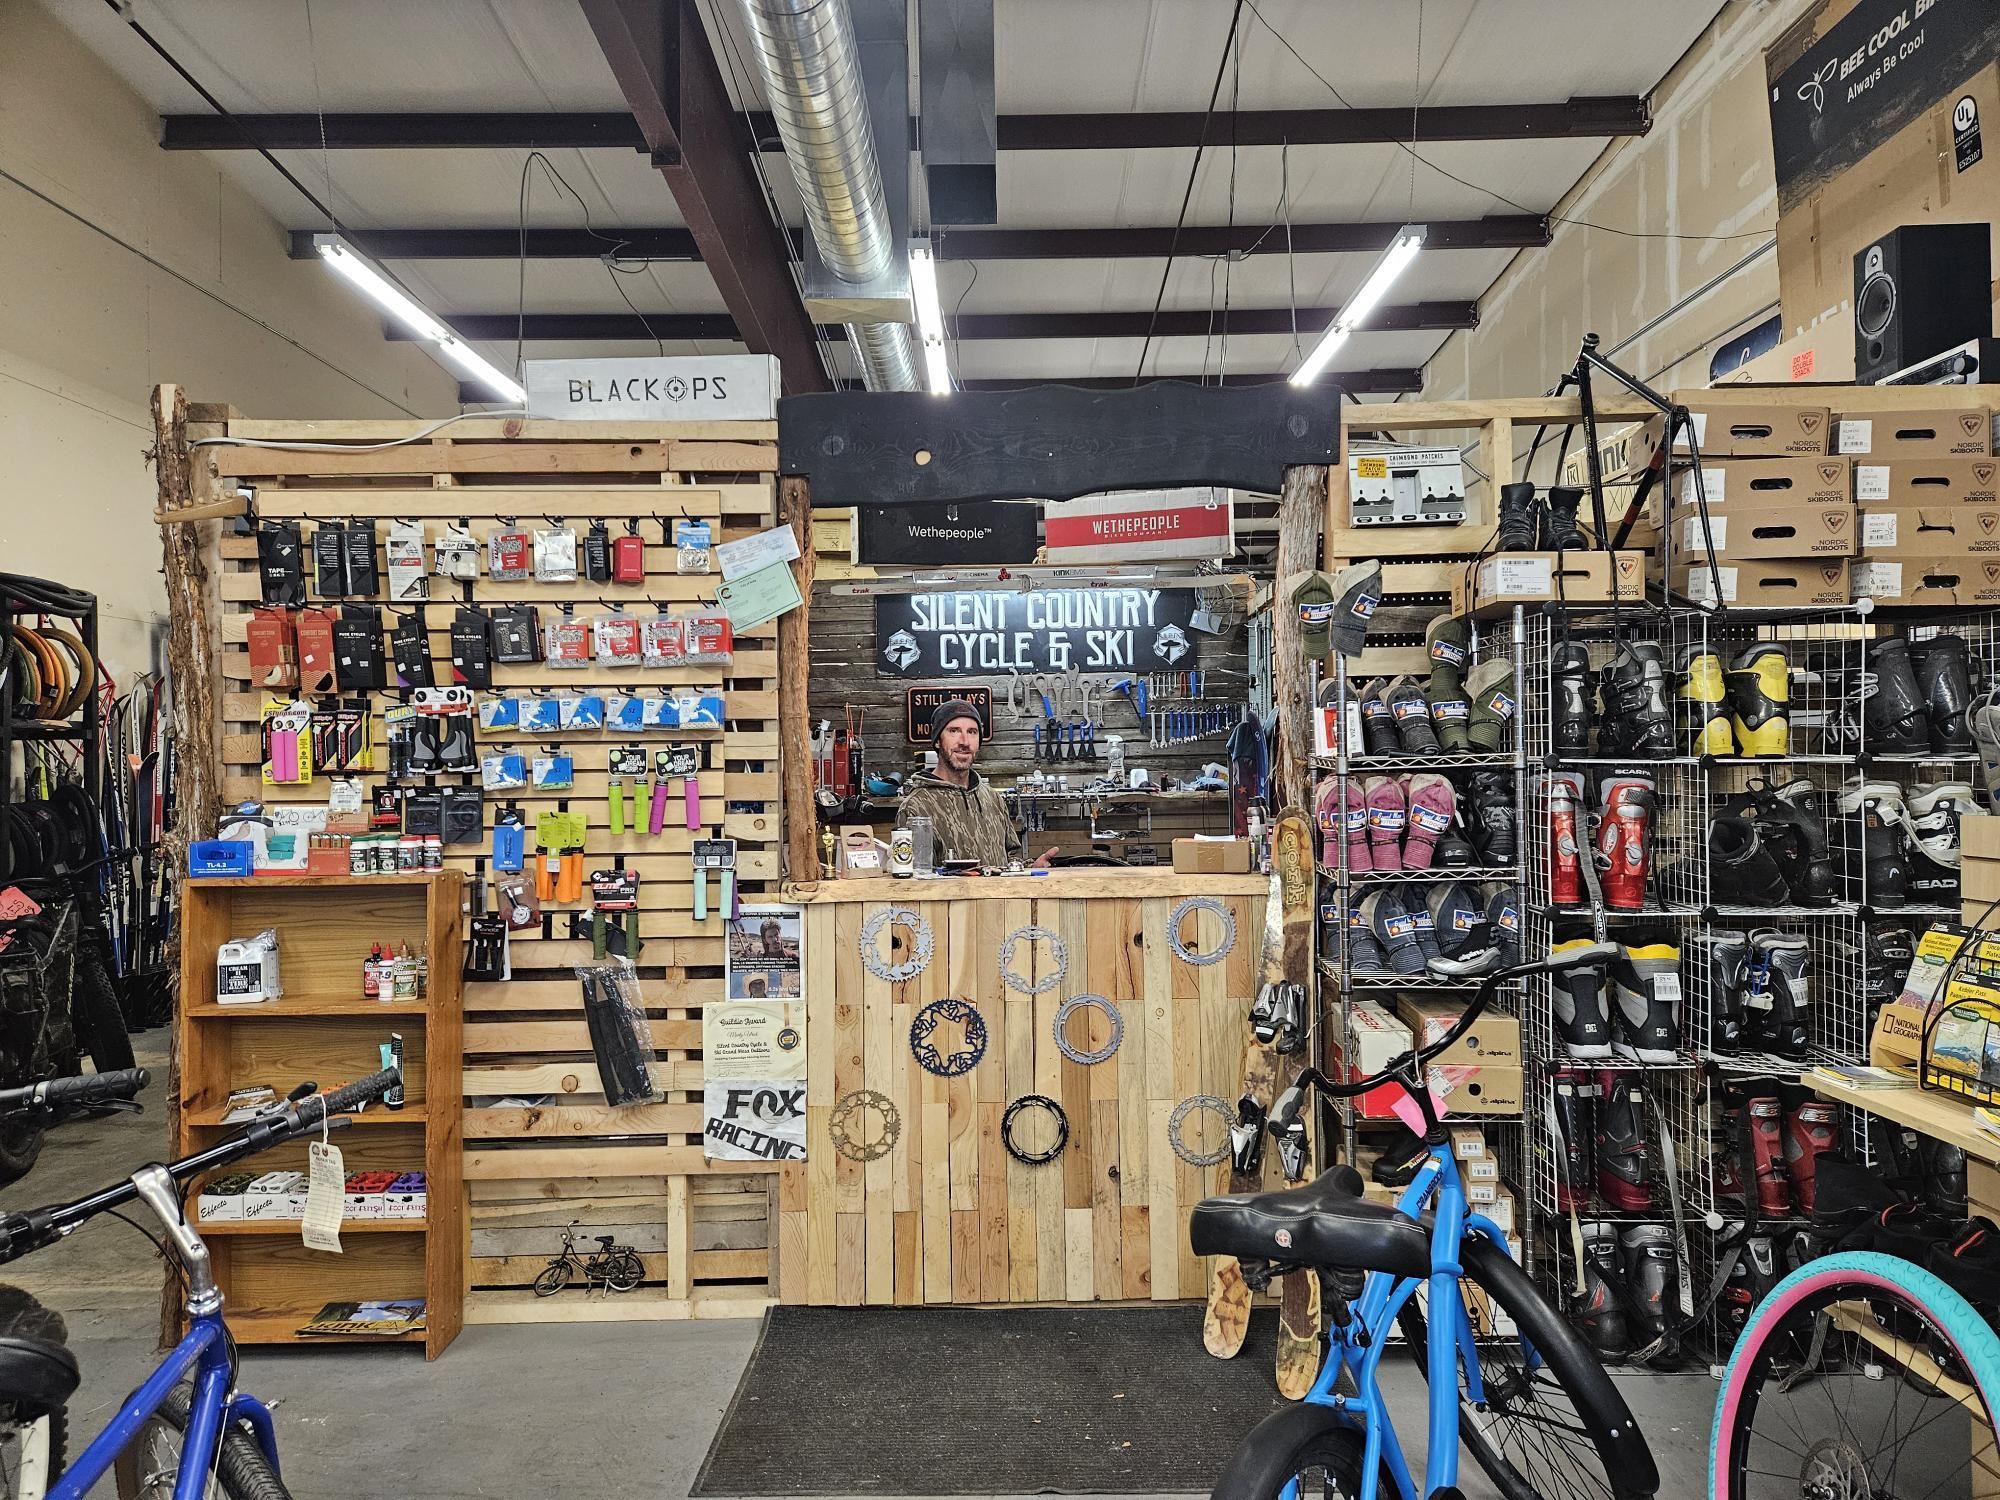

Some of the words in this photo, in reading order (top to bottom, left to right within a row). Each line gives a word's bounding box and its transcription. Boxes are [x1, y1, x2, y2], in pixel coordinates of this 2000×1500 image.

[1840, 52, 1865, 81] BEE
[1868, 9, 1910, 56] COOL
[1847, 67, 1881, 103] Always
[1883, 53, 1897, 74] Be
[1899, 29, 1925, 60] Cool
[1957, 105, 1972, 123] UL
[1802, 352, 1812, 360] NOT
[1792, 360, 1813, 372] DOUBLE
[1794, 368, 1812, 378] STACK
[1092, 514, 1180, 535] WETHEPEOPLE
[721, 588, 732, 600] C
[910, 591, 1010, 632] SILENT
[1026, 588, 1161, 630] COUNTRY
[938, 632, 1034, 670] CYCLE
[1049, 632, 1072, 668] &
[1086, 630, 1134, 667] SKI
[914, 693, 948, 706] STILL
[916, 723, 933, 736] NO
[121, 731, 129, 804] ROSSIGNOL
[1907, 879, 1958, 890] HEAD
[1458, 949, 1484, 962] alpina
[1585, 1024, 1597, 1033] DC
[1656, 1028, 1668, 1037] DC
[1896, 1019, 1921, 1033] NATIONAL
[1894, 1027, 1924, 1042] GEOGRAPHI
[723, 1089, 806, 1120] FOX
[705, 1117, 806, 1160] RACING
[1416, 1168, 1444, 1210] CRANBROOK
[200, 1201, 228, 1218] Effects
[246, 1199, 272, 1217] Effects
